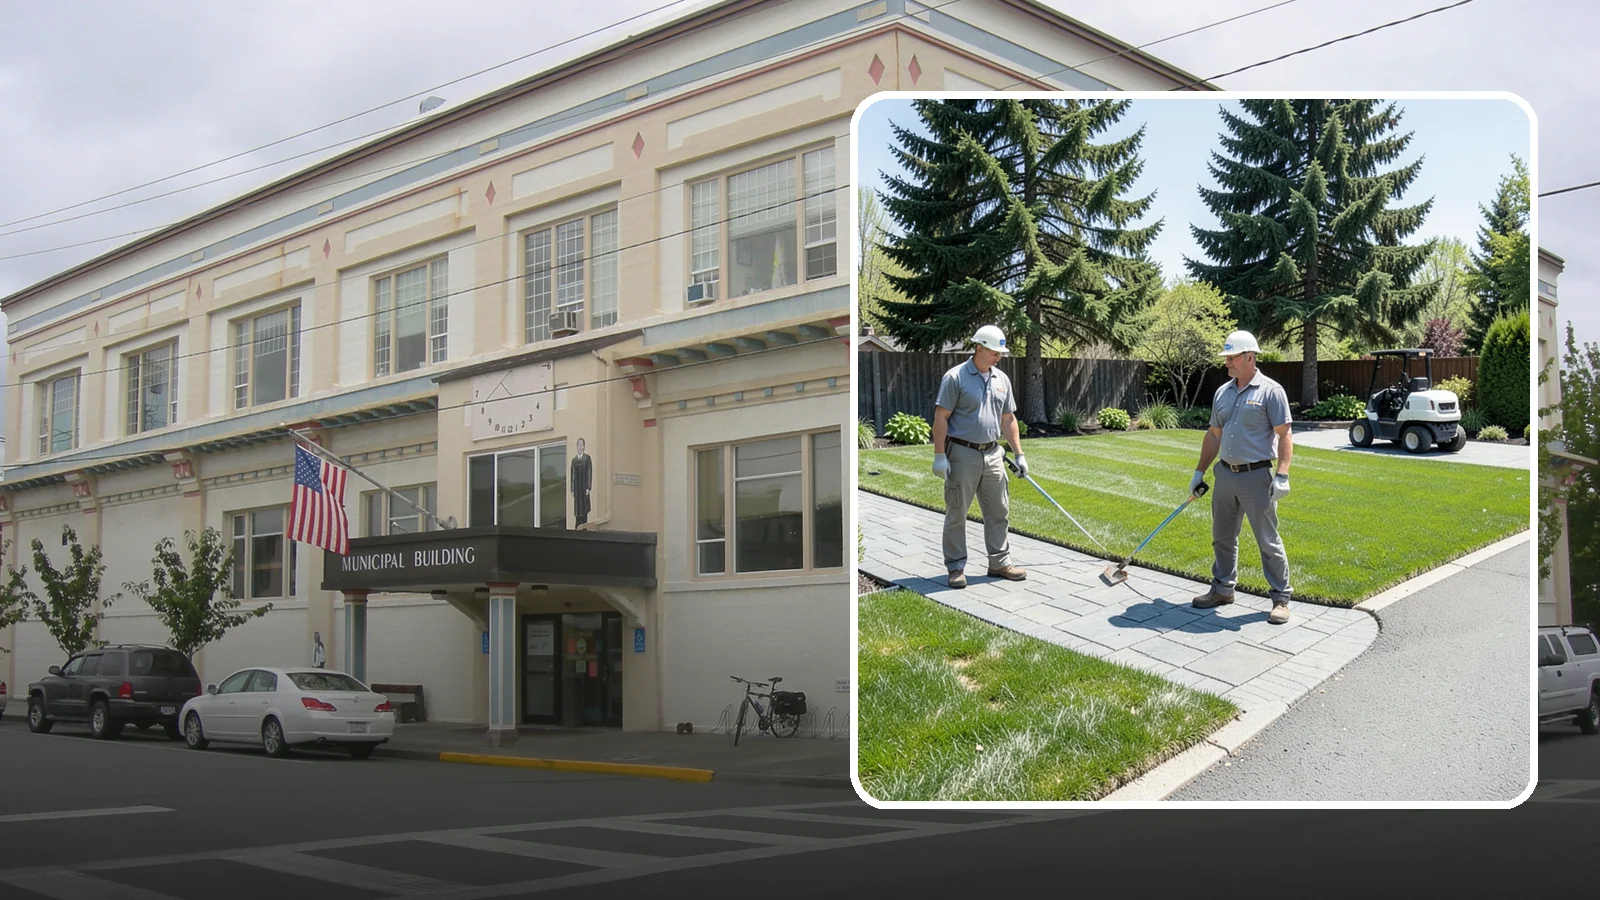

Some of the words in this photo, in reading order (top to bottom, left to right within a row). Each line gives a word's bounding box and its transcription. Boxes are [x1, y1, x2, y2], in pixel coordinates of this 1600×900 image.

[488, 418, 492, 426] 9
[494, 424, 500, 432] 10
[508, 426, 513, 434] 12
[529, 414, 533, 422] 3
[342, 552, 405, 572] MUNICIPAL
[414, 546, 475, 567] BUILDING
